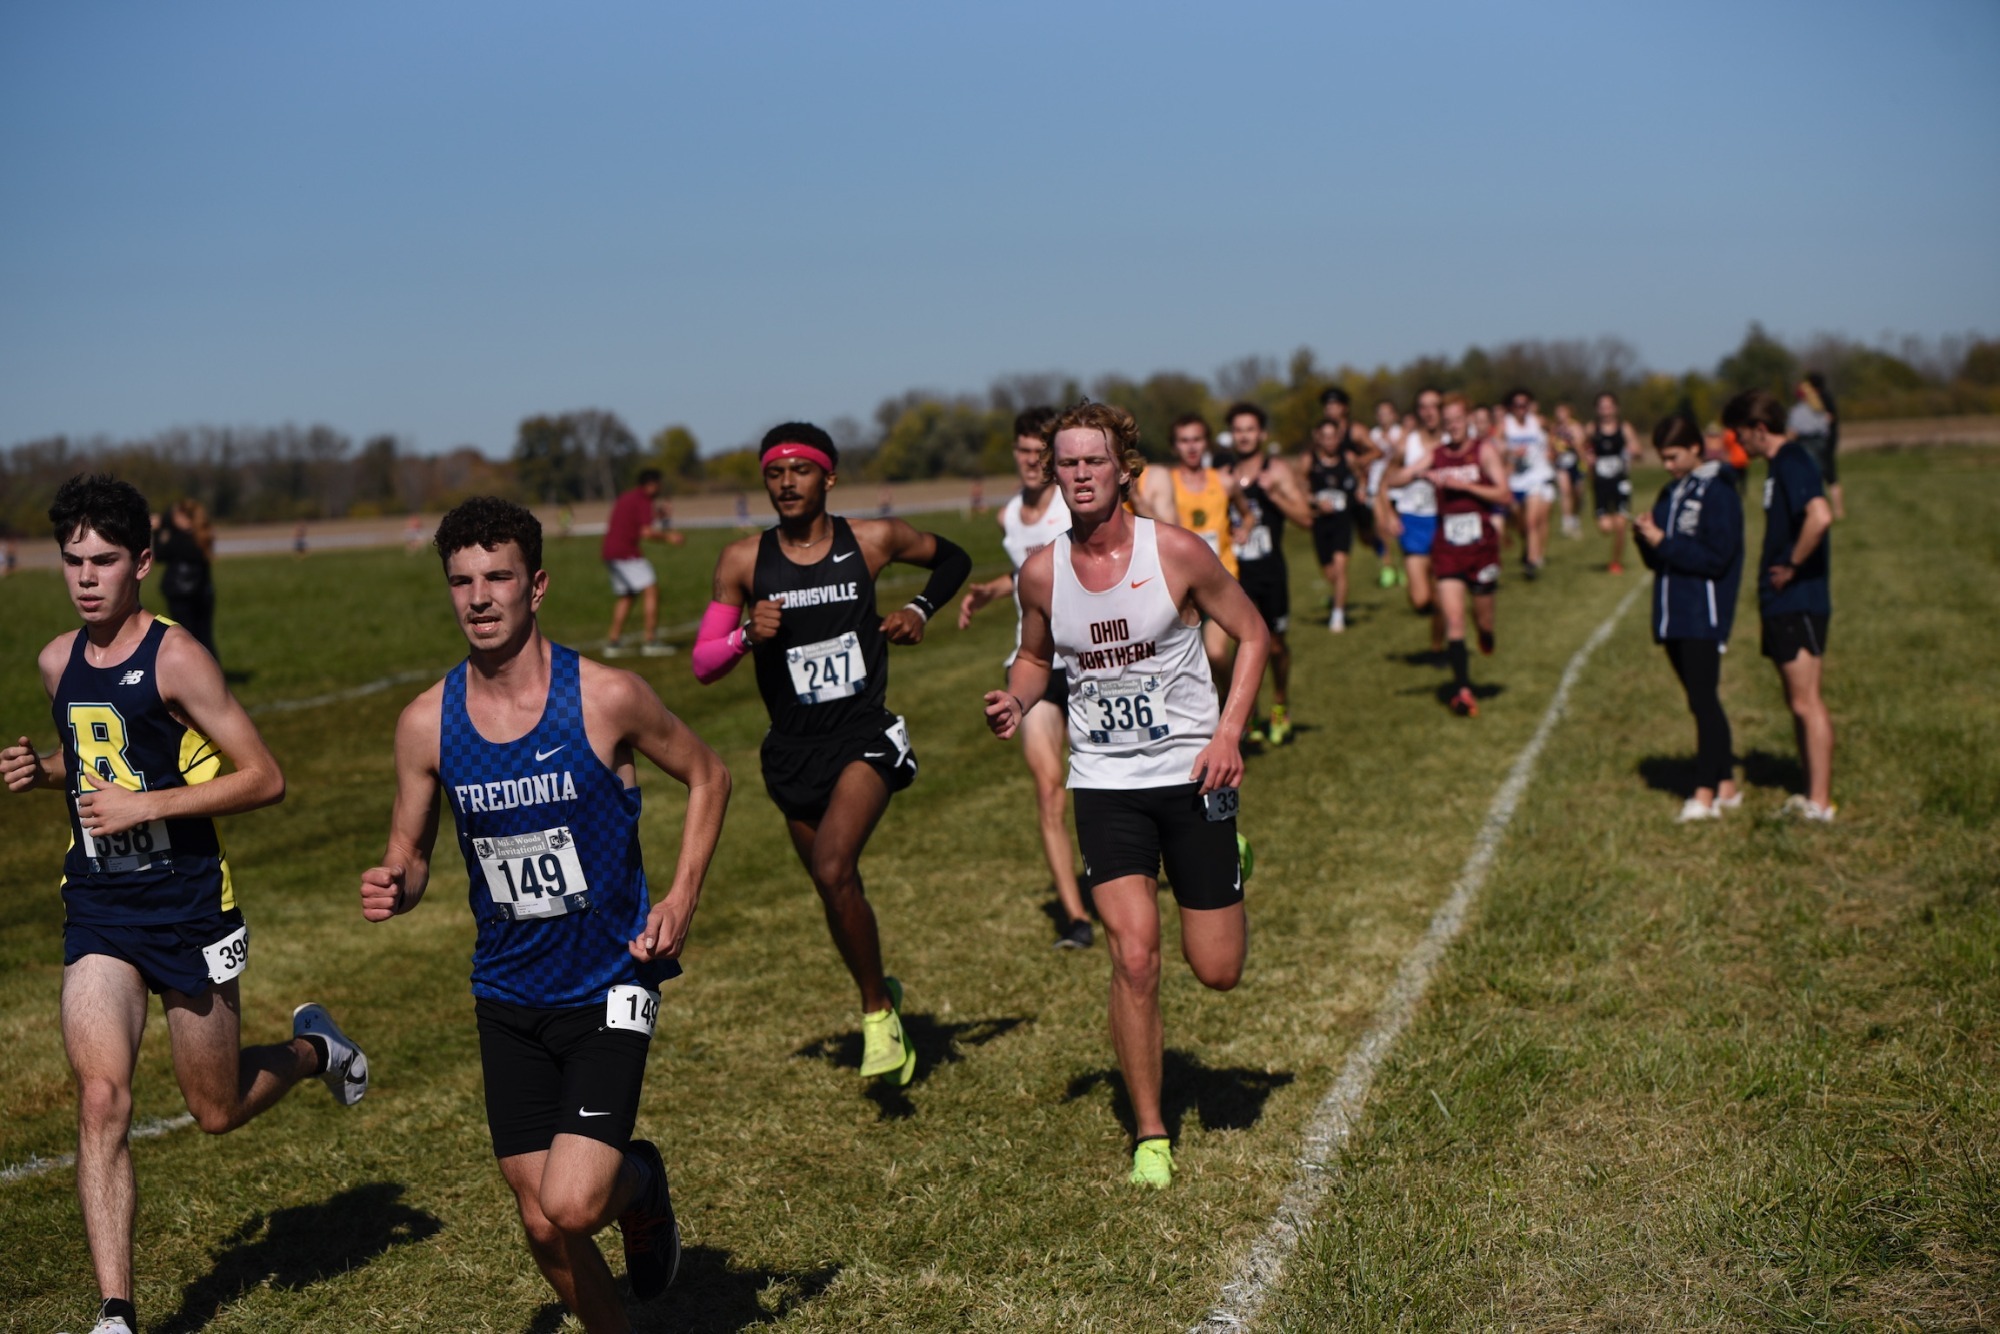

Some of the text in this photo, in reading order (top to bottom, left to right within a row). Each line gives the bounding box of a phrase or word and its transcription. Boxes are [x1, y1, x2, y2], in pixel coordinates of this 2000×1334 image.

[1090, 618, 1129, 645] OHIO
[804, 652, 850, 690] 247
[1076, 640, 1155, 672] NORTHERN
[1098, 694, 1154, 731] 336
[68, 702, 147, 793] R
[455, 771, 578, 815] FREDONIA
[1216, 790, 1238, 814] 33
[497, 839, 515, 848] Mike
[515, 834, 542, 845] Woods
[497, 842, 546, 856] Invitational
[498, 854, 567, 902] 149
